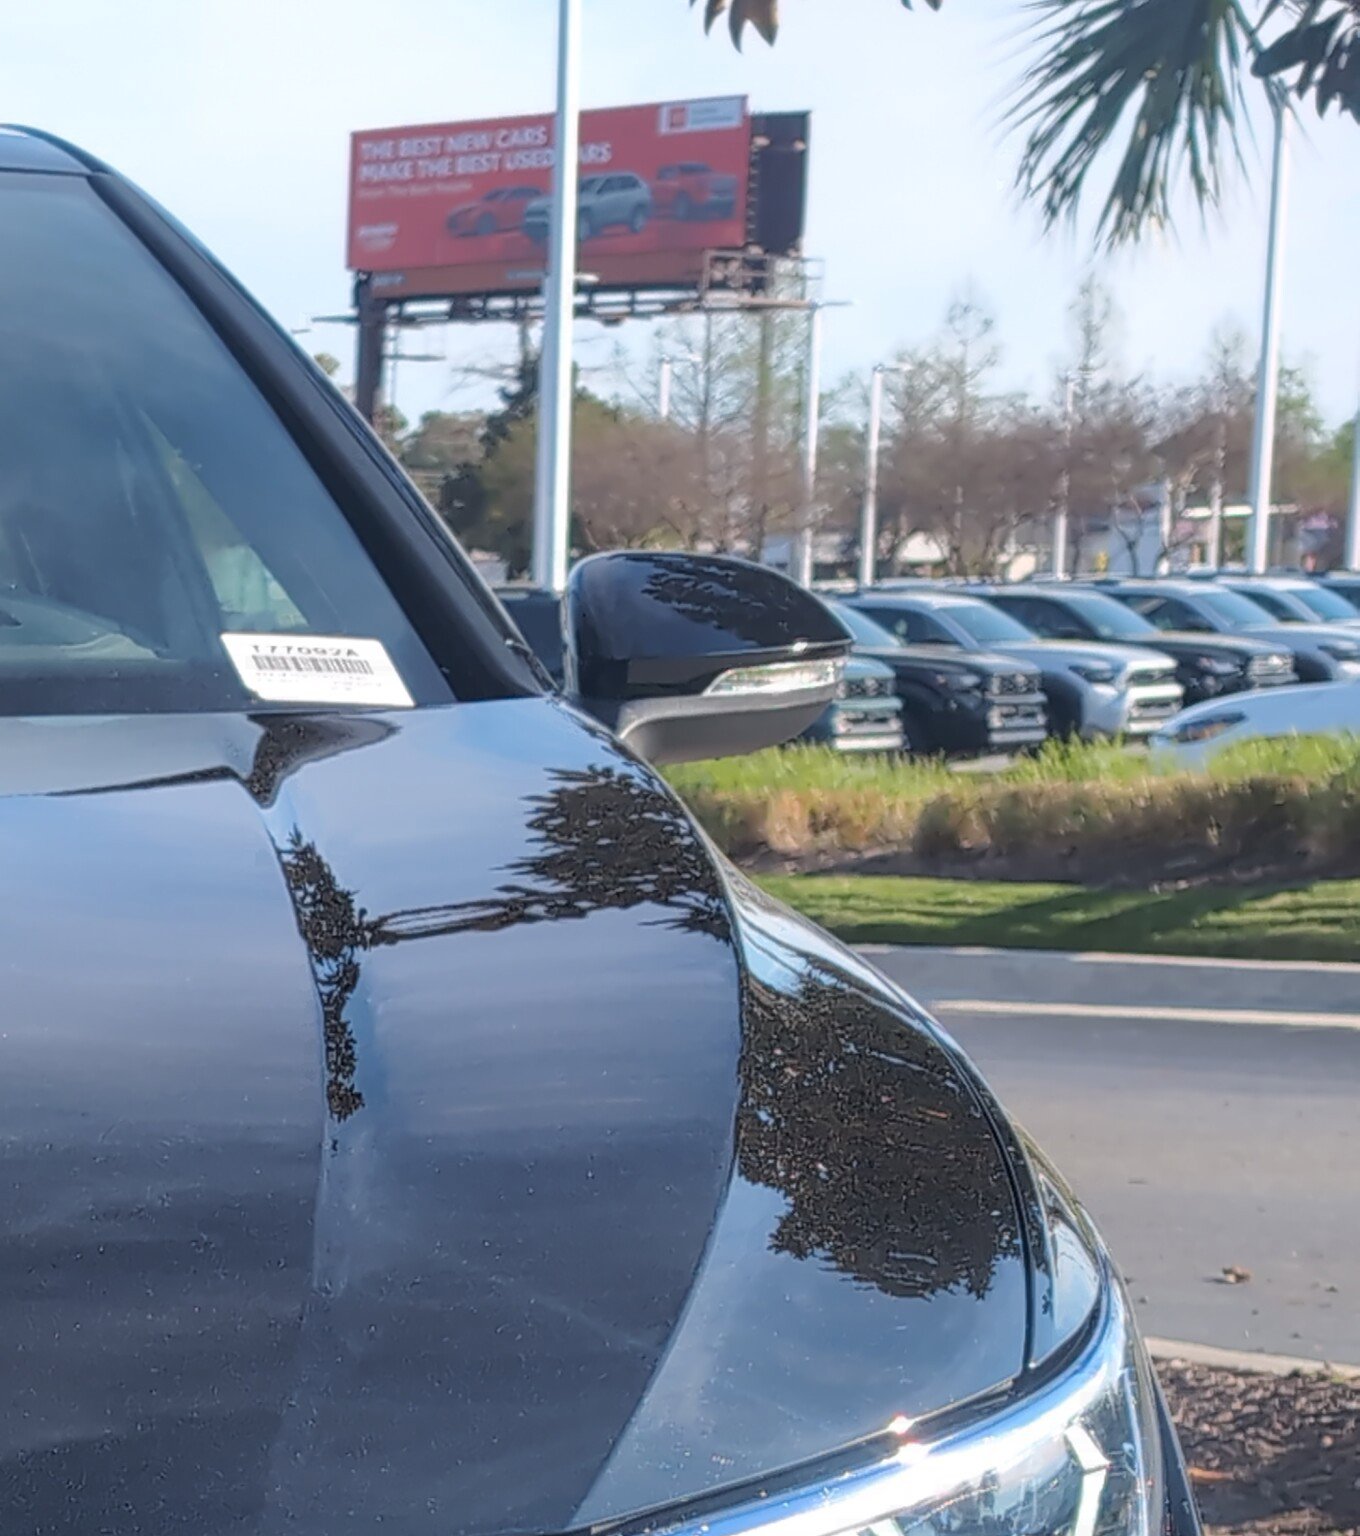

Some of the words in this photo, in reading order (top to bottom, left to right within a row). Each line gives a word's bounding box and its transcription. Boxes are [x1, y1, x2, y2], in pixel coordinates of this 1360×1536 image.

[361, 141, 395, 160] THE
[399, 137, 443, 157] BEST
[447, 132, 490, 153] NEW
[495, 126, 547, 148] CARS
[360, 160, 413, 181] MAKE
[417, 157, 453, 177] THE
[457, 152, 501, 174] BEST
[505, 148, 557, 171] USED
